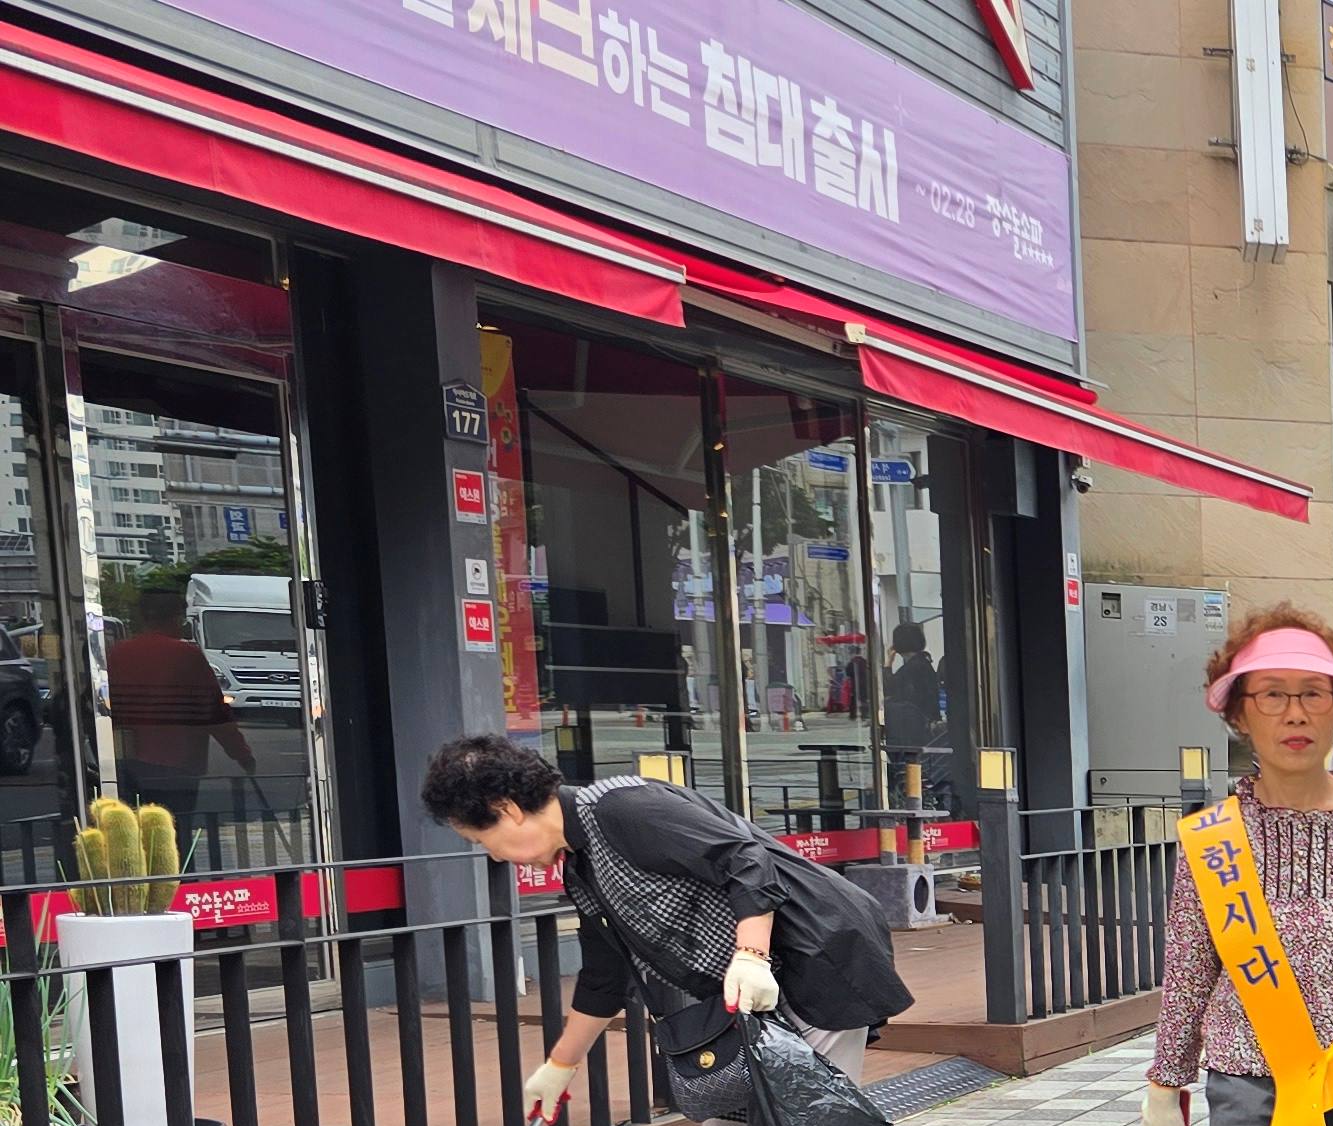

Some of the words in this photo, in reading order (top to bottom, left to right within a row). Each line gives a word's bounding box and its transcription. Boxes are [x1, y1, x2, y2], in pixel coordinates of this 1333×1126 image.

[700, 38, 806, 184] 침대
[810, 95, 900, 224] 출시
[452, 409, 481, 436] 177
